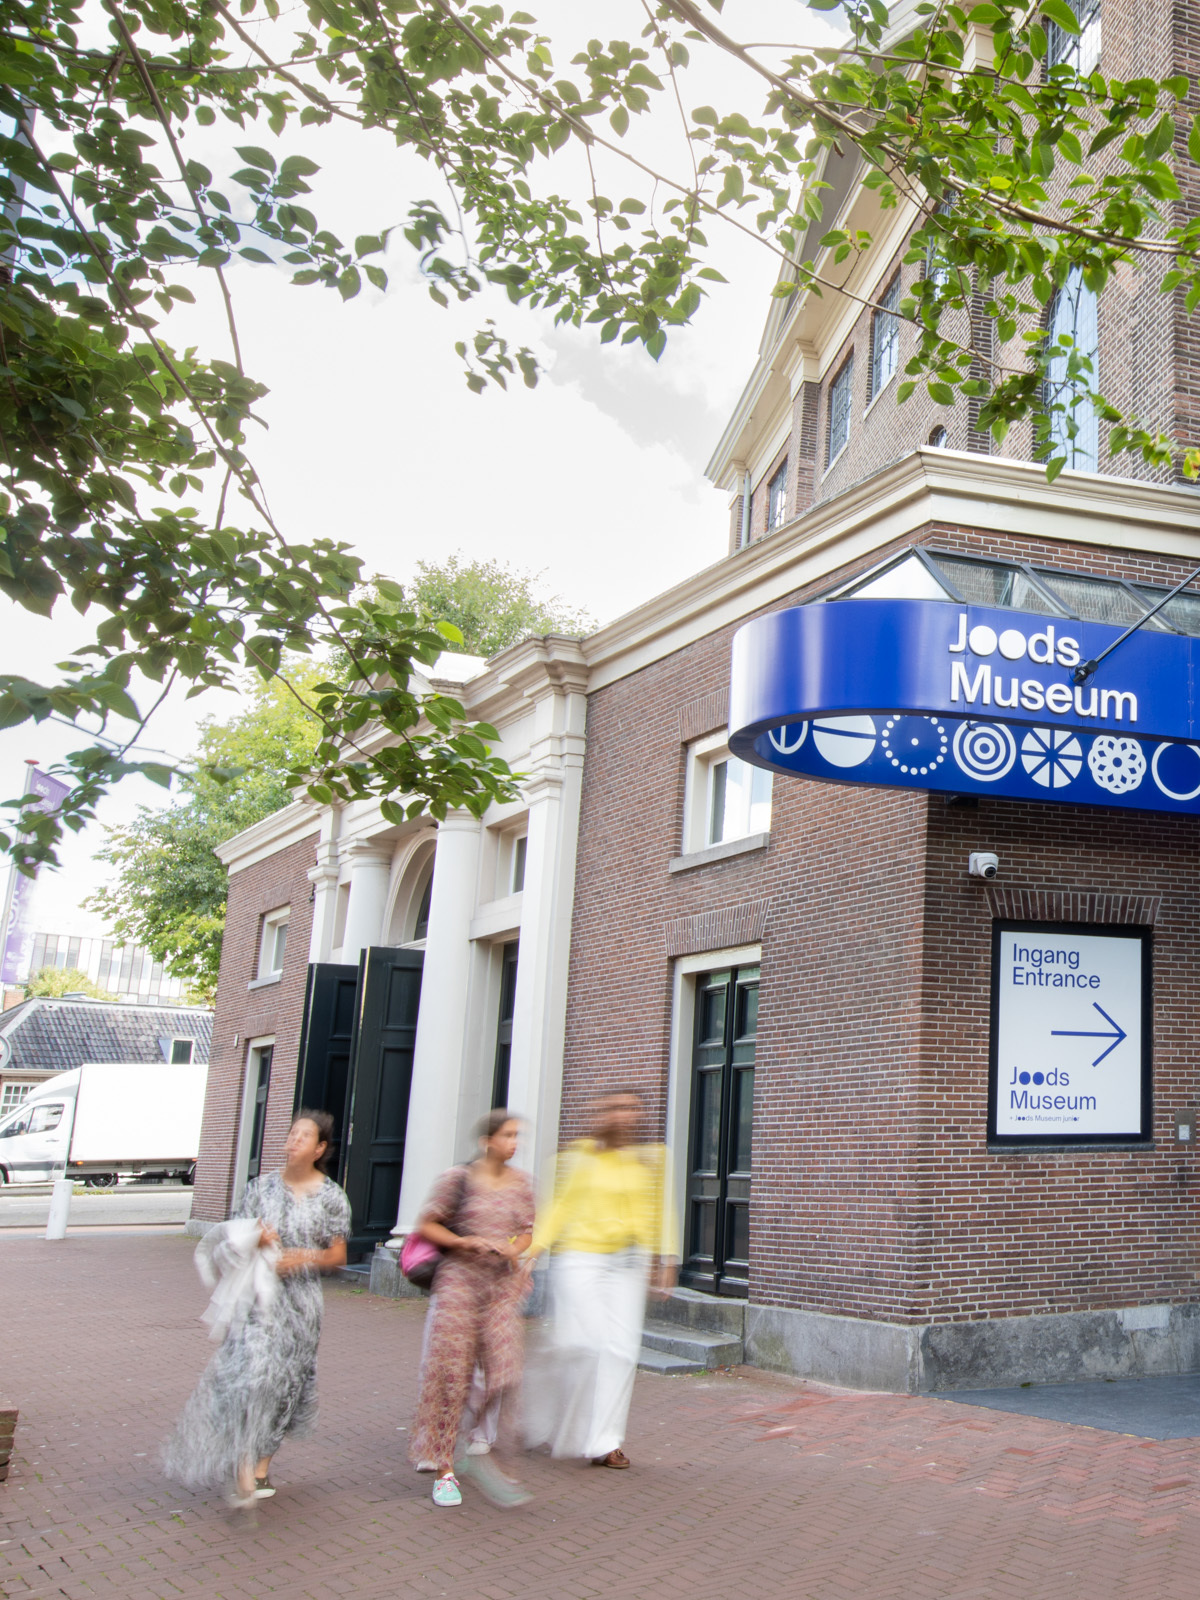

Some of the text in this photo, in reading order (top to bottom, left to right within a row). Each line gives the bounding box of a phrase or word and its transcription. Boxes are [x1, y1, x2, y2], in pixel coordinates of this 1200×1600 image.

[949, 613, 1080, 667] Joods
[951, 661, 1138, 722] Museum
[1013, 943, 1080, 969] Ingang
[1012, 967, 1101, 989] Entrance
[1010, 1066, 1070, 1086] Joods
[1010, 1090, 1097, 1110] Museum
[1062, 1115, 1080, 1123] junior
